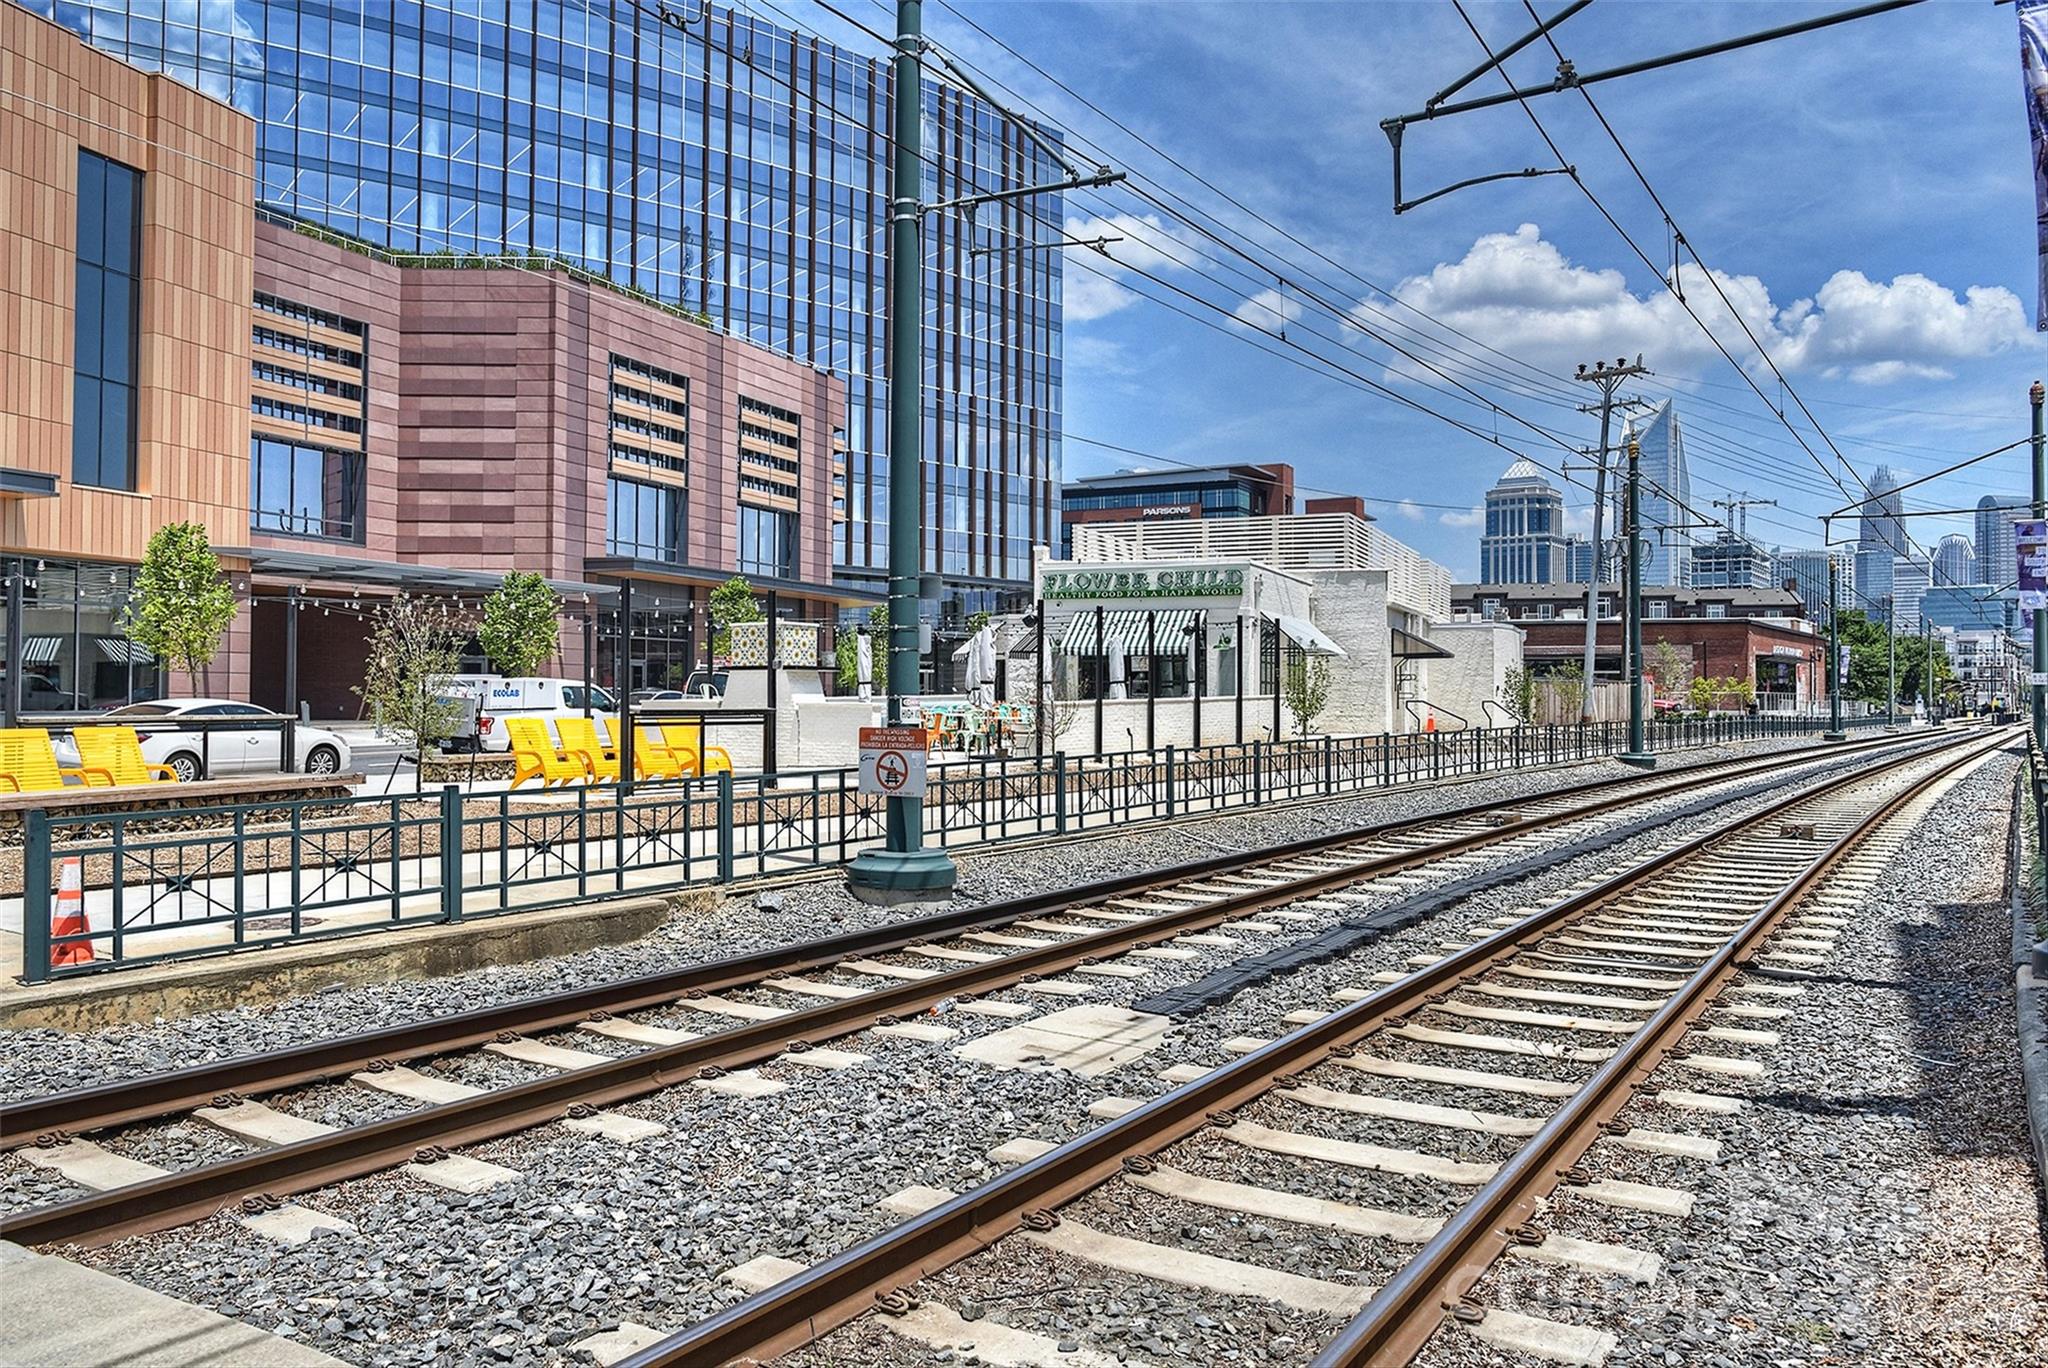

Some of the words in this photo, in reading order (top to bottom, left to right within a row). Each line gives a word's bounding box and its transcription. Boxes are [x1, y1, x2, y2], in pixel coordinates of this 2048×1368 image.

[1143, 507, 1191, 516] PARSONS
[1043, 572, 1151, 590] FLOWER
[1157, 569, 1244, 588] CHILD
[1044, 591, 1092, 599] HEALTHY
[1096, 590, 1123, 598] FOOD
[1127, 589, 1147, 597] FOR
[1150, 589, 1158, 597] A
[1161, 588, 1197, 597] HAPPY
[1201, 587, 1242, 595] WORLD
[493, 689, 520, 698] ECOLAB
